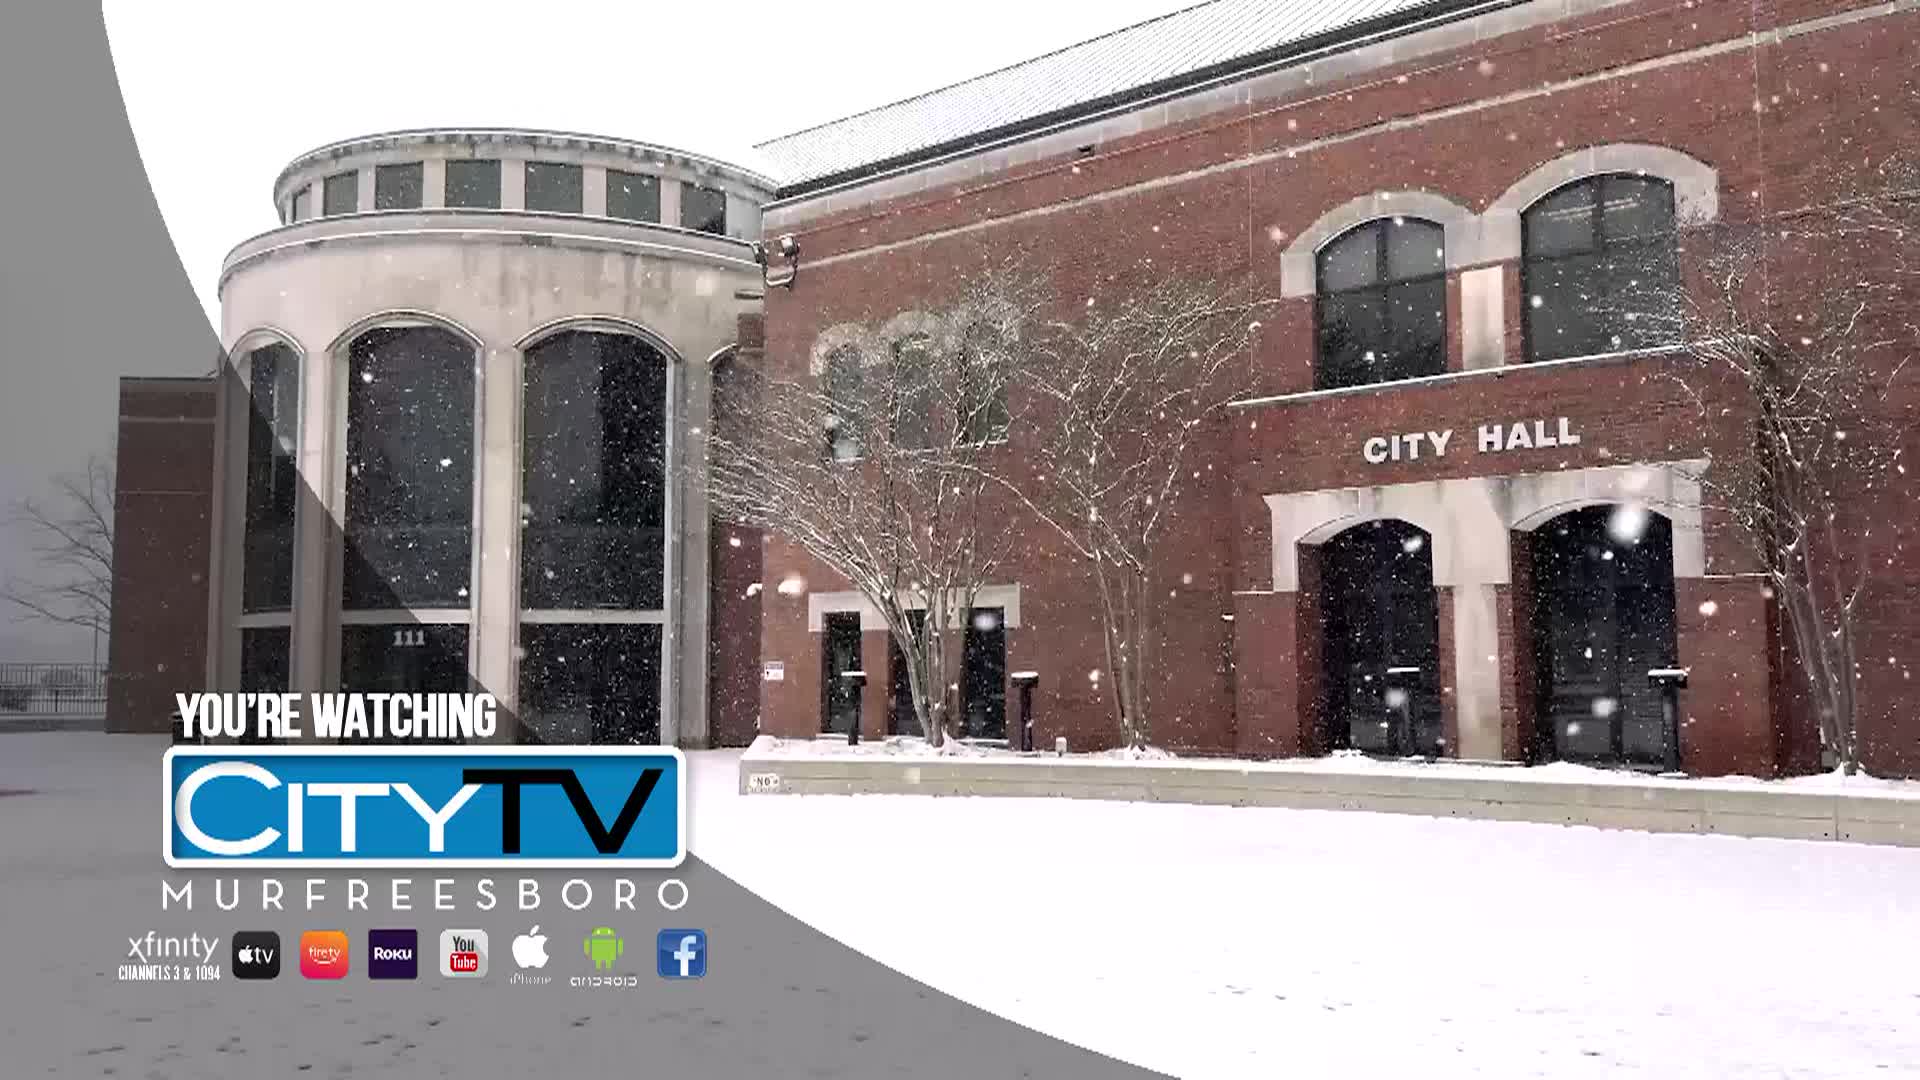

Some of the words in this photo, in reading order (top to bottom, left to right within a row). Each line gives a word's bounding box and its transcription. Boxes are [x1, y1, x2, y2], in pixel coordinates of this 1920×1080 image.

[1363, 430, 1453, 464] CITY
[1478, 417, 1581, 452] HALL
[392, 630, 425, 646] 111
